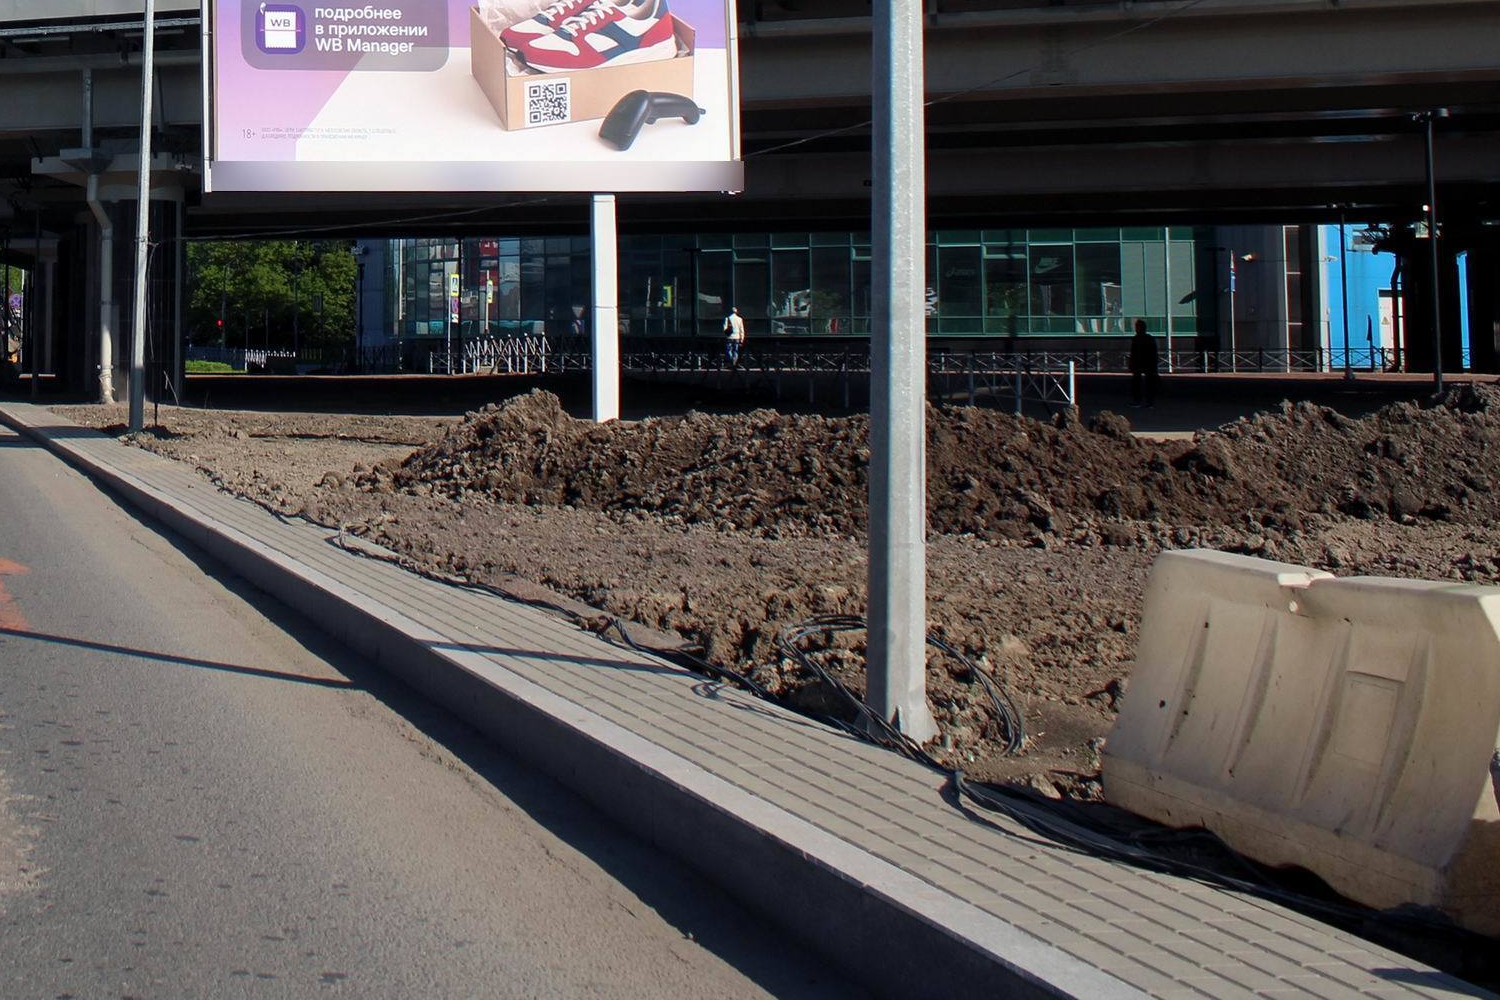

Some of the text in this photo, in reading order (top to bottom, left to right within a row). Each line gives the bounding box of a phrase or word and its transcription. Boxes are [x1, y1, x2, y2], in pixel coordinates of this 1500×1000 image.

[315, 6, 402, 22] подробнее
[271, 18, 291, 27] WB
[315, 25, 428, 38] в приложении
[315, 38, 414, 55] WB Manager
[243, 128, 255, 139] 18+
